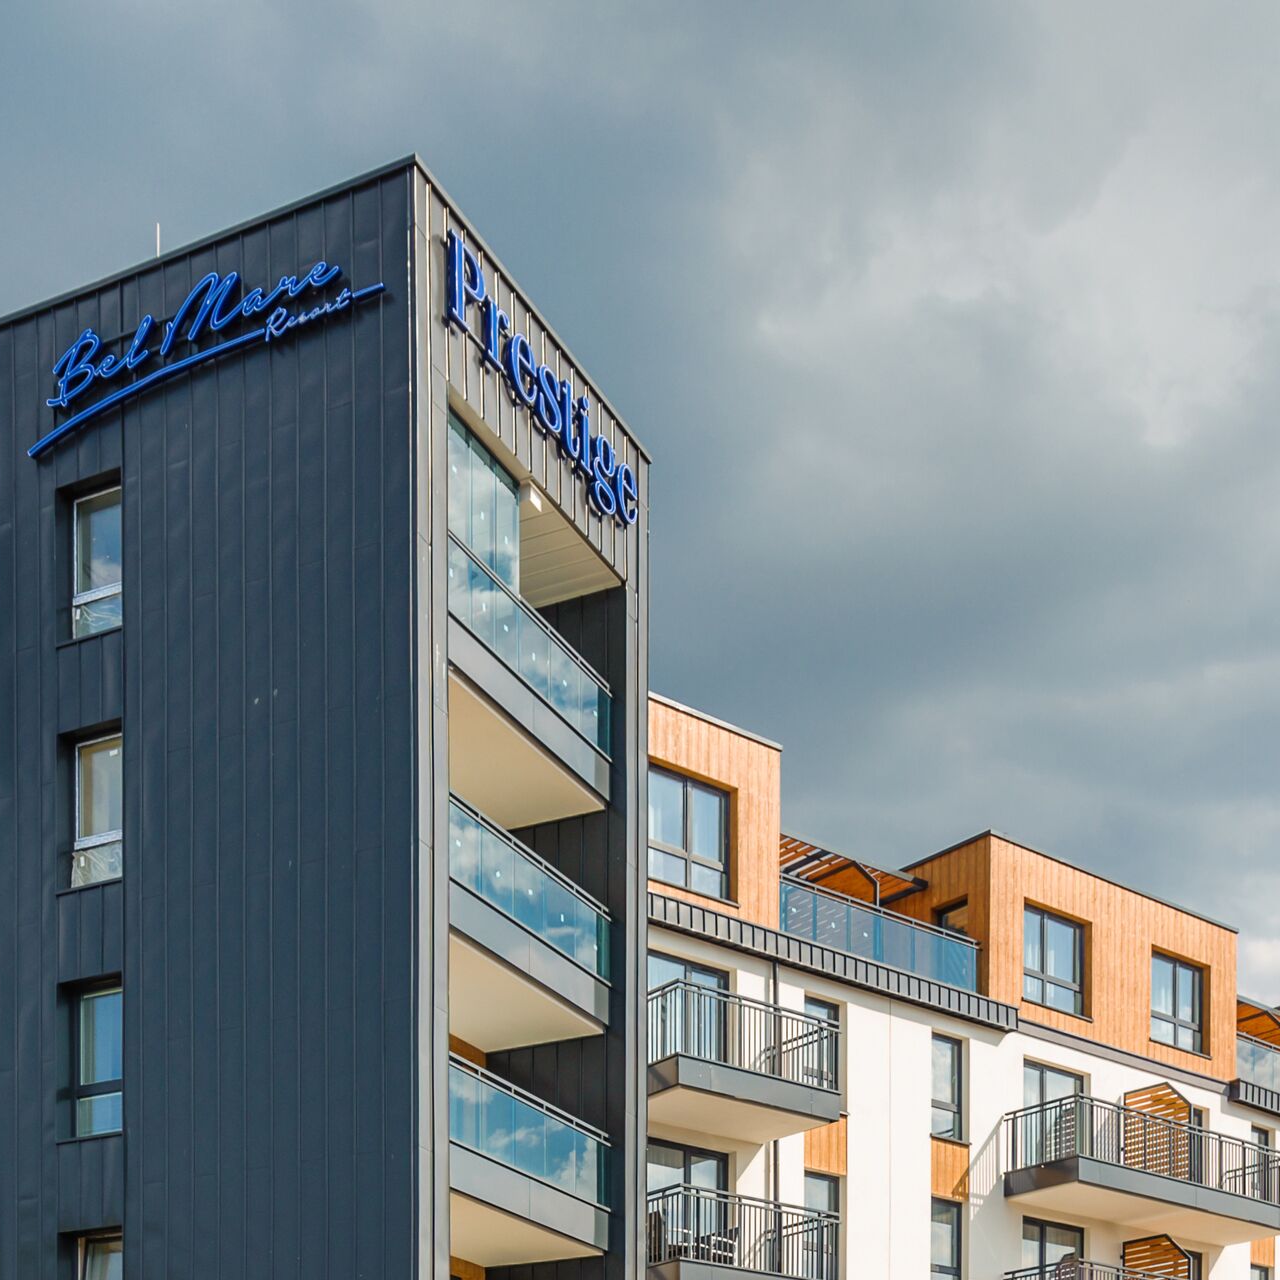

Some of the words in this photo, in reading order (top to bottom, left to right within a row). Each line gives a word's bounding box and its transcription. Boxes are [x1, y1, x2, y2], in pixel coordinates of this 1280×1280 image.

[46, 314, 156, 407] Bel
[160, 260, 345, 356] Mare
[265, 287, 354, 342] Resort
[447, 228, 638, 525] Prestige
